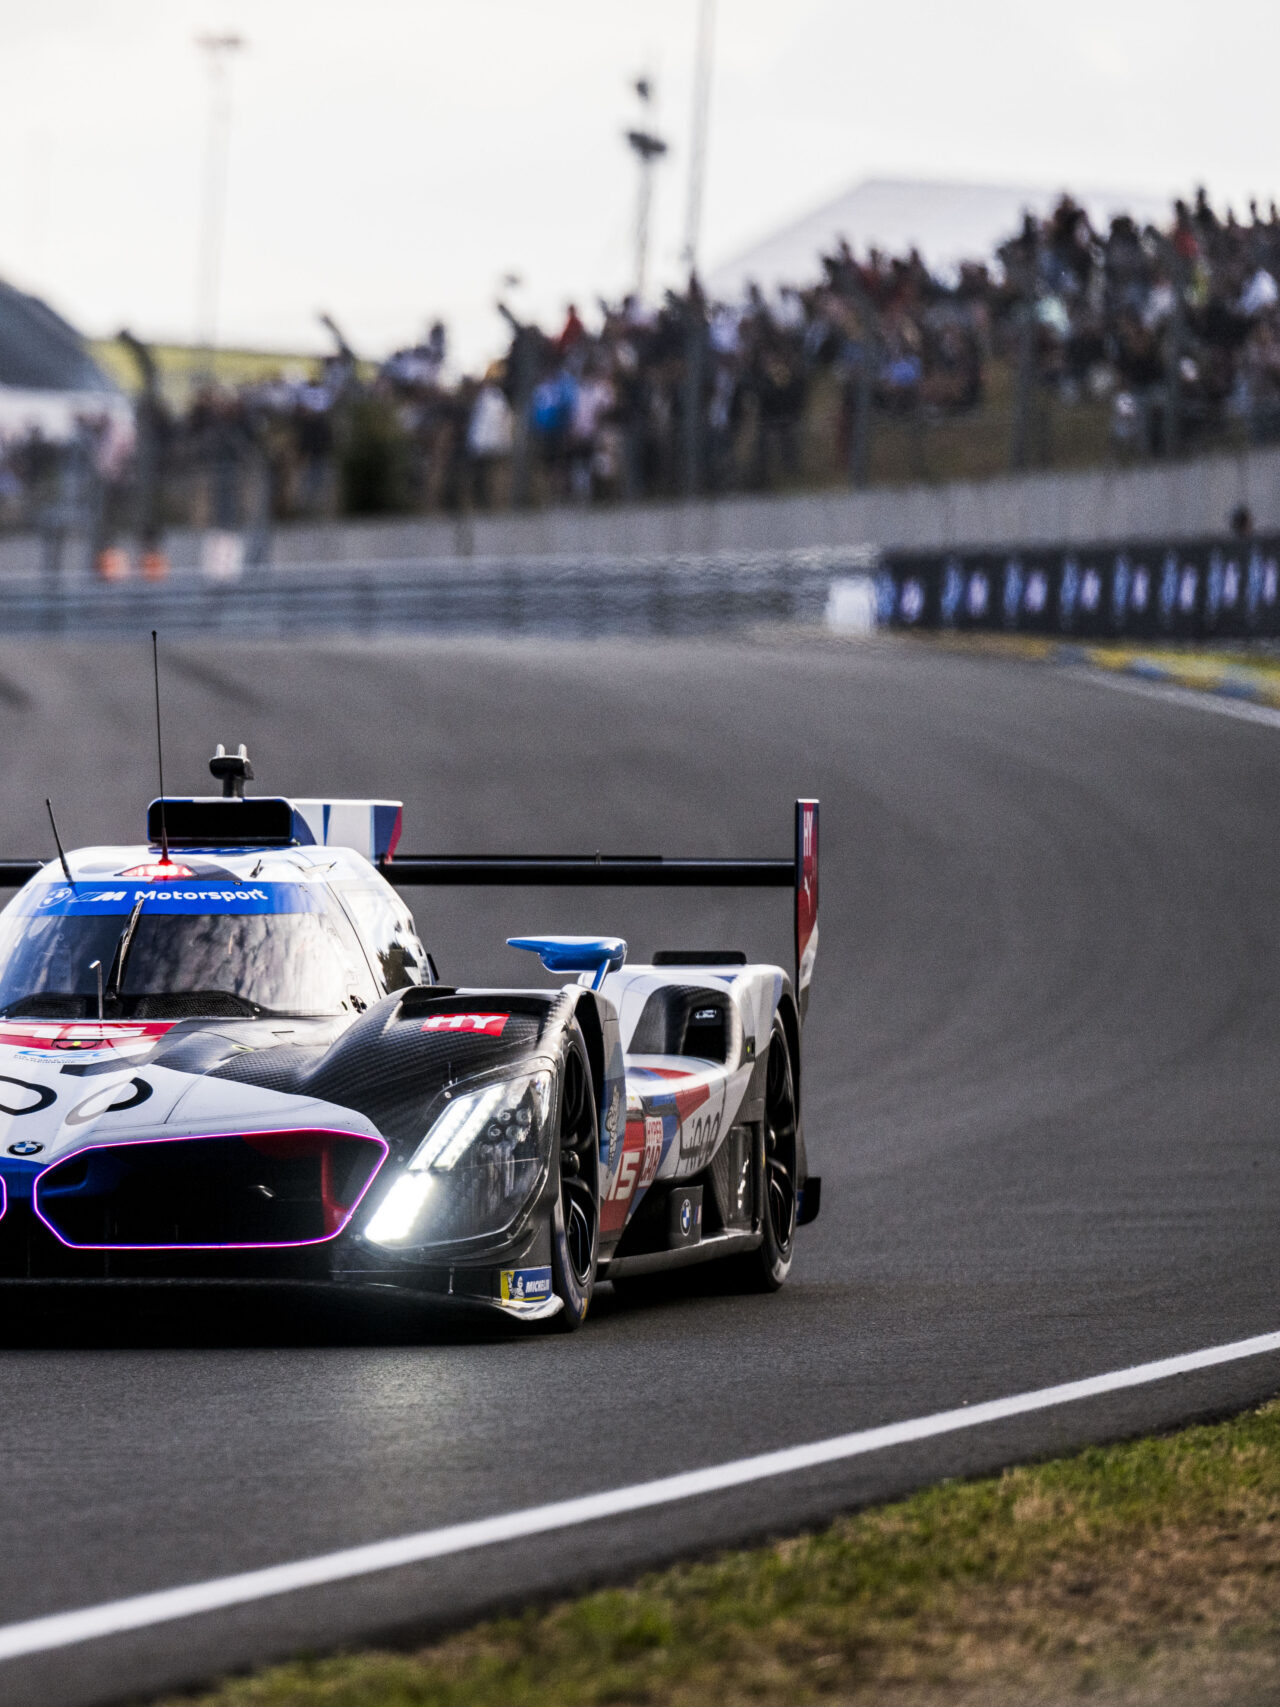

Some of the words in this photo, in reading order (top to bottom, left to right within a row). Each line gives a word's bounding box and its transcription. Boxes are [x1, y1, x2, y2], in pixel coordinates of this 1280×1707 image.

[88, 891, 127, 901] M
[134, 888, 269, 902] Motorsport
[426, 1015, 504, 1029] HY
[608, 1151, 641, 1200] 15
